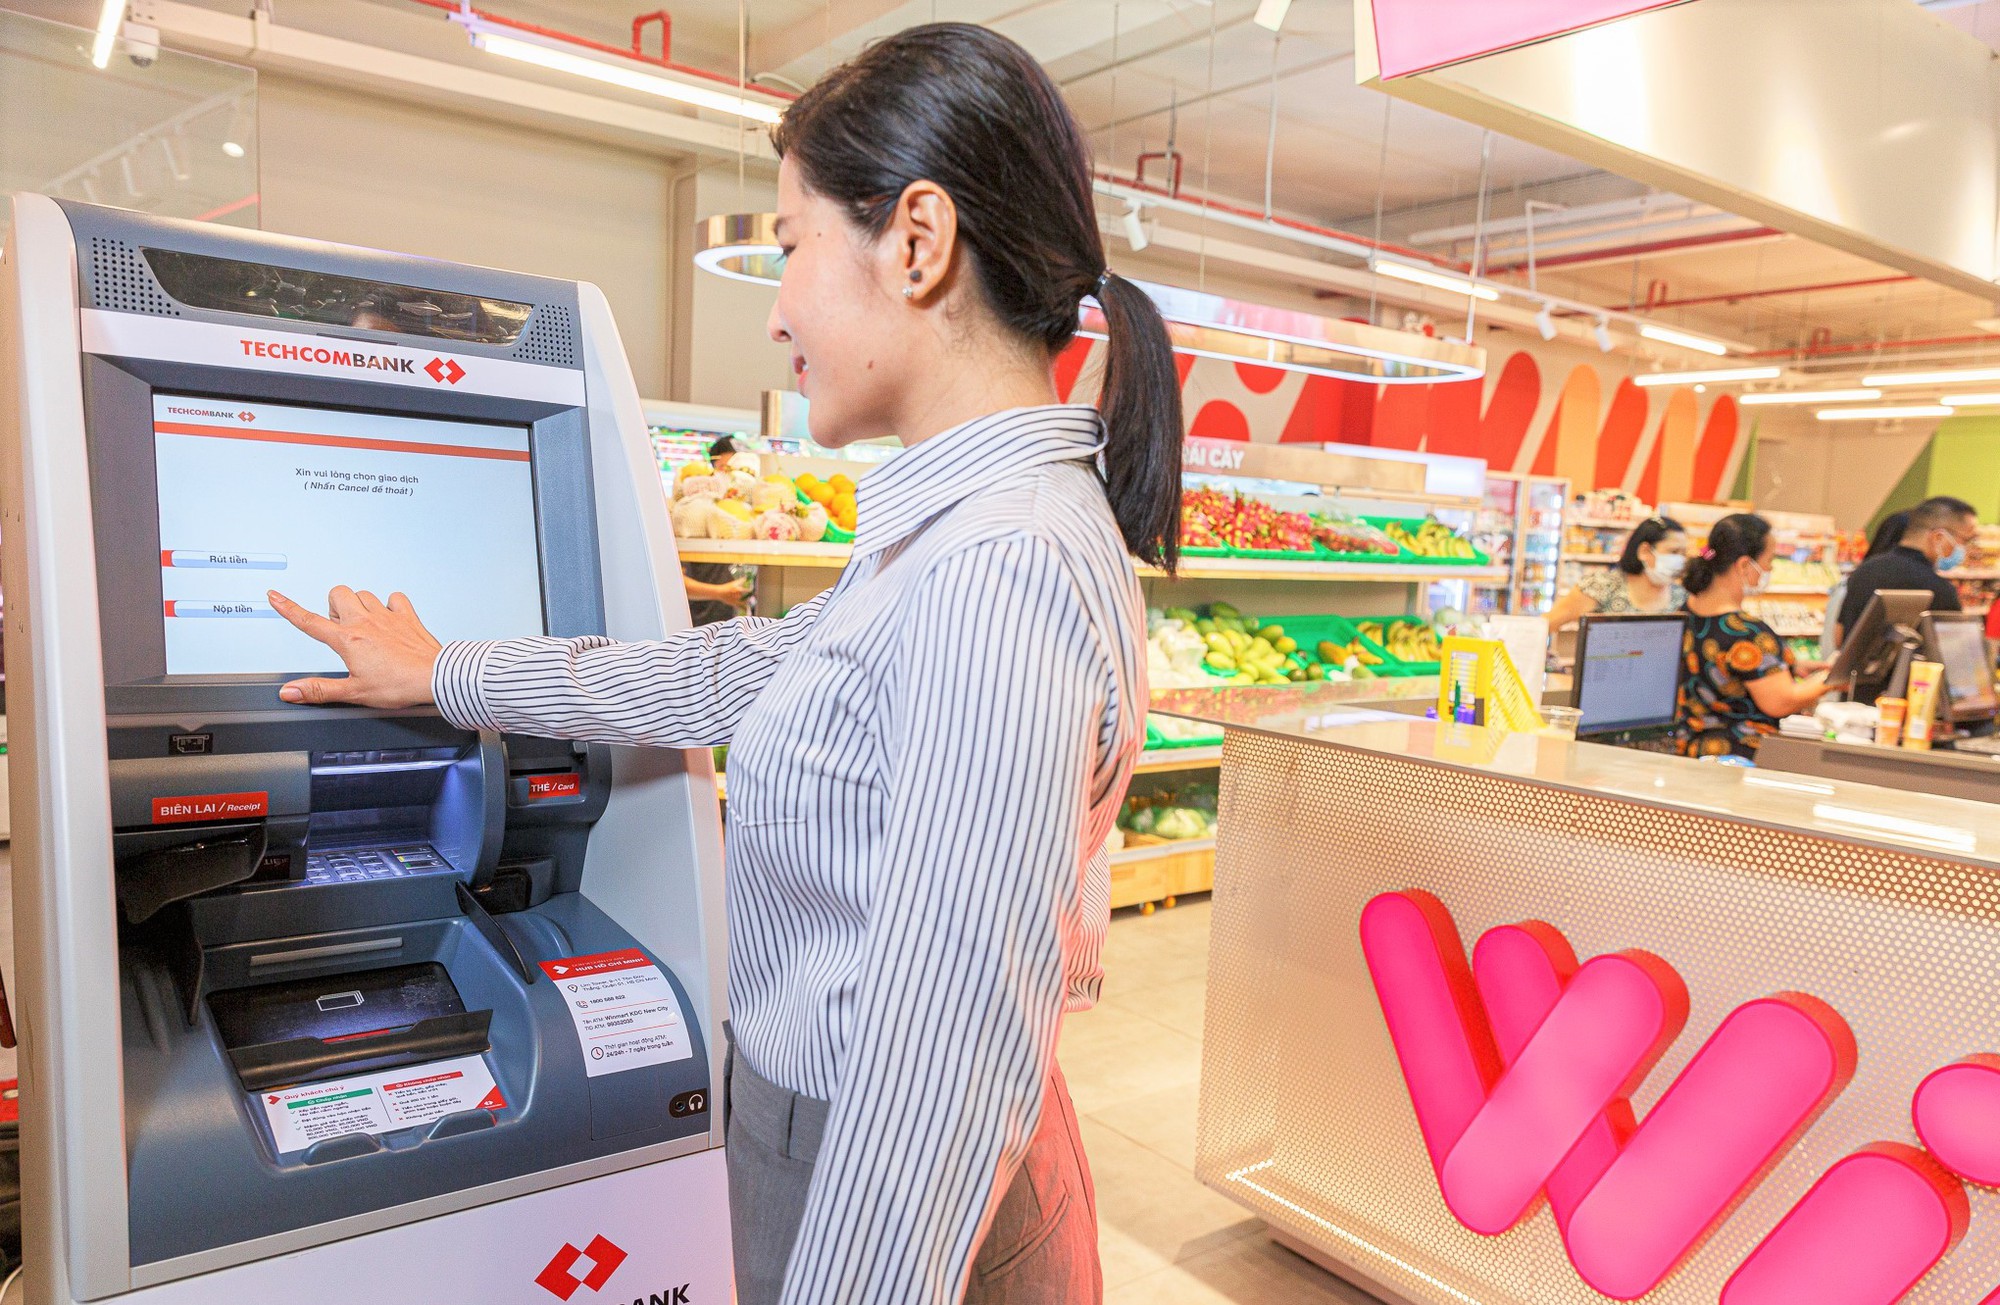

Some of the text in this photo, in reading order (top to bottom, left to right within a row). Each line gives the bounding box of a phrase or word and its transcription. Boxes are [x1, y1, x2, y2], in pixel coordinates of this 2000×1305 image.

[240, 340, 415, 374] TECHCOMBANK
[167, 407, 234, 418] TECHCOMBANK
[295, 467, 311, 477] Xin
[330, 470, 351, 481] lòng
[353, 471, 376, 481] chọn
[378, 474, 398, 484] giao
[400, 475, 419, 484] dịch
[209, 554, 248, 564] Rút tiền
[213, 603, 253, 614] Nộp tiền
[160, 803, 191, 816] BIÊN
[195, 803, 216, 814] LAI
[227, 803, 261, 812] Receipt
